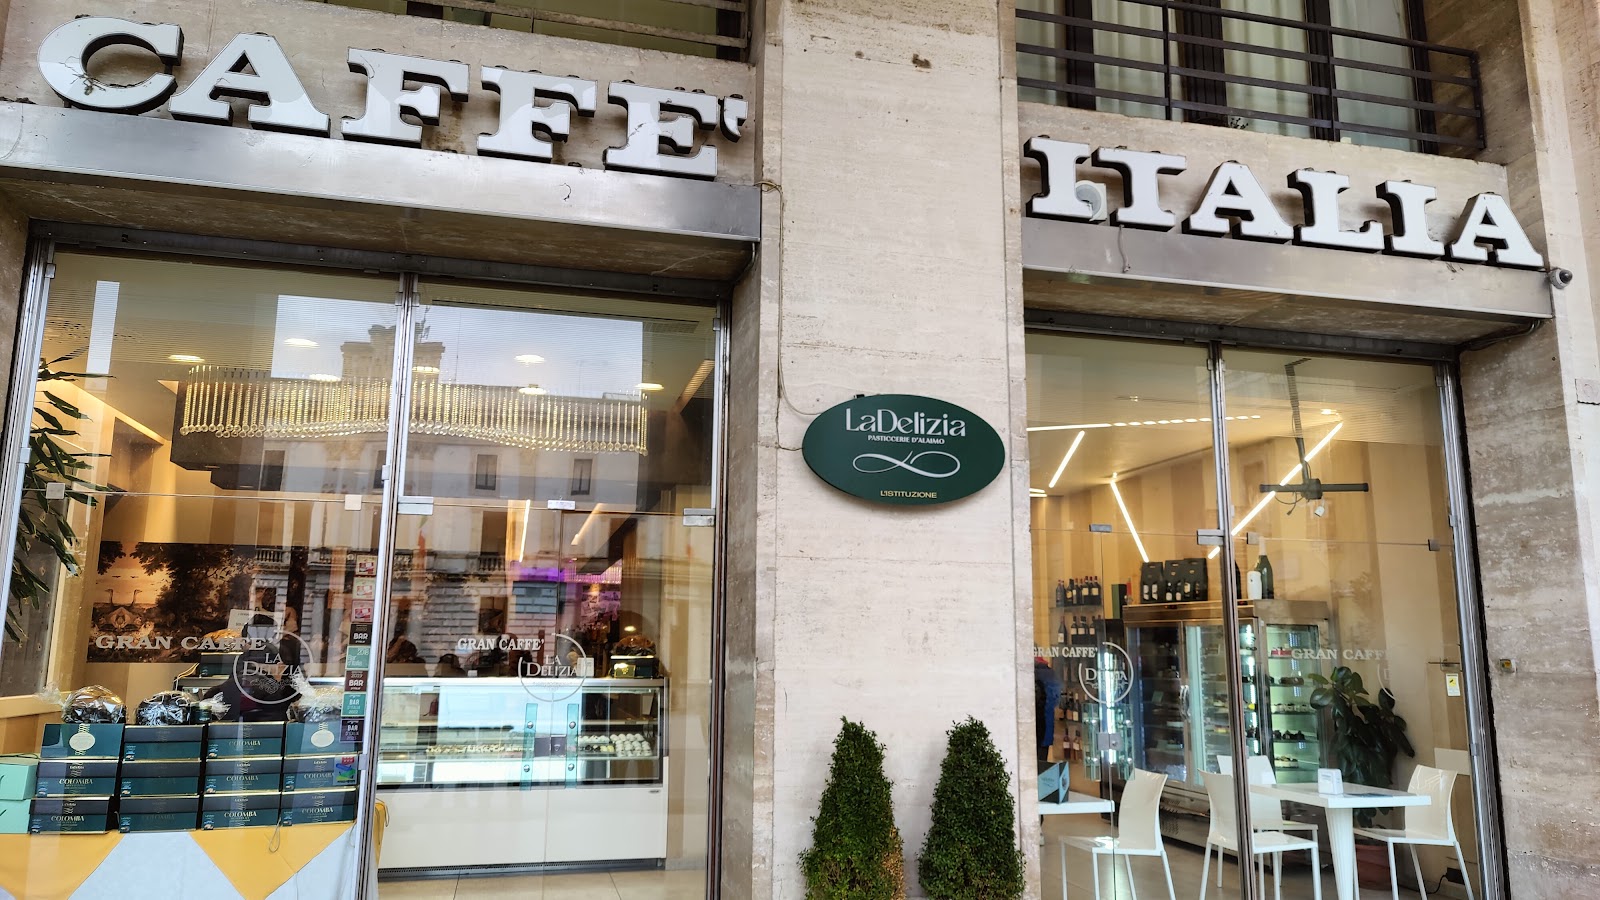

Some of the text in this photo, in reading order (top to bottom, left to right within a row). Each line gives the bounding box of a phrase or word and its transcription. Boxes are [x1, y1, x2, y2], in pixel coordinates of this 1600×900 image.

[37, 16, 748, 179] CAFFE'
[1024, 136, 1545, 268] ITALIA
[845, 407, 966, 437] LaDelizia
[867, 434, 945, 445] PASTICCERIE D'ALAIMO
[880, 490, 938, 499] L'ISTITUZIONE
[353, 632, 368, 640] BAR
[95, 635, 274, 652] GRAN CAFFE'
[457, 638, 545, 651] GRAN CAFFE'
[265, 652, 283, 664] LA
[1062, 646, 1098, 658] CAFFE'
[1291, 649, 1338, 660] GRAN
[545, 654, 562, 665] LA
[348, 679, 364, 687] BAR
